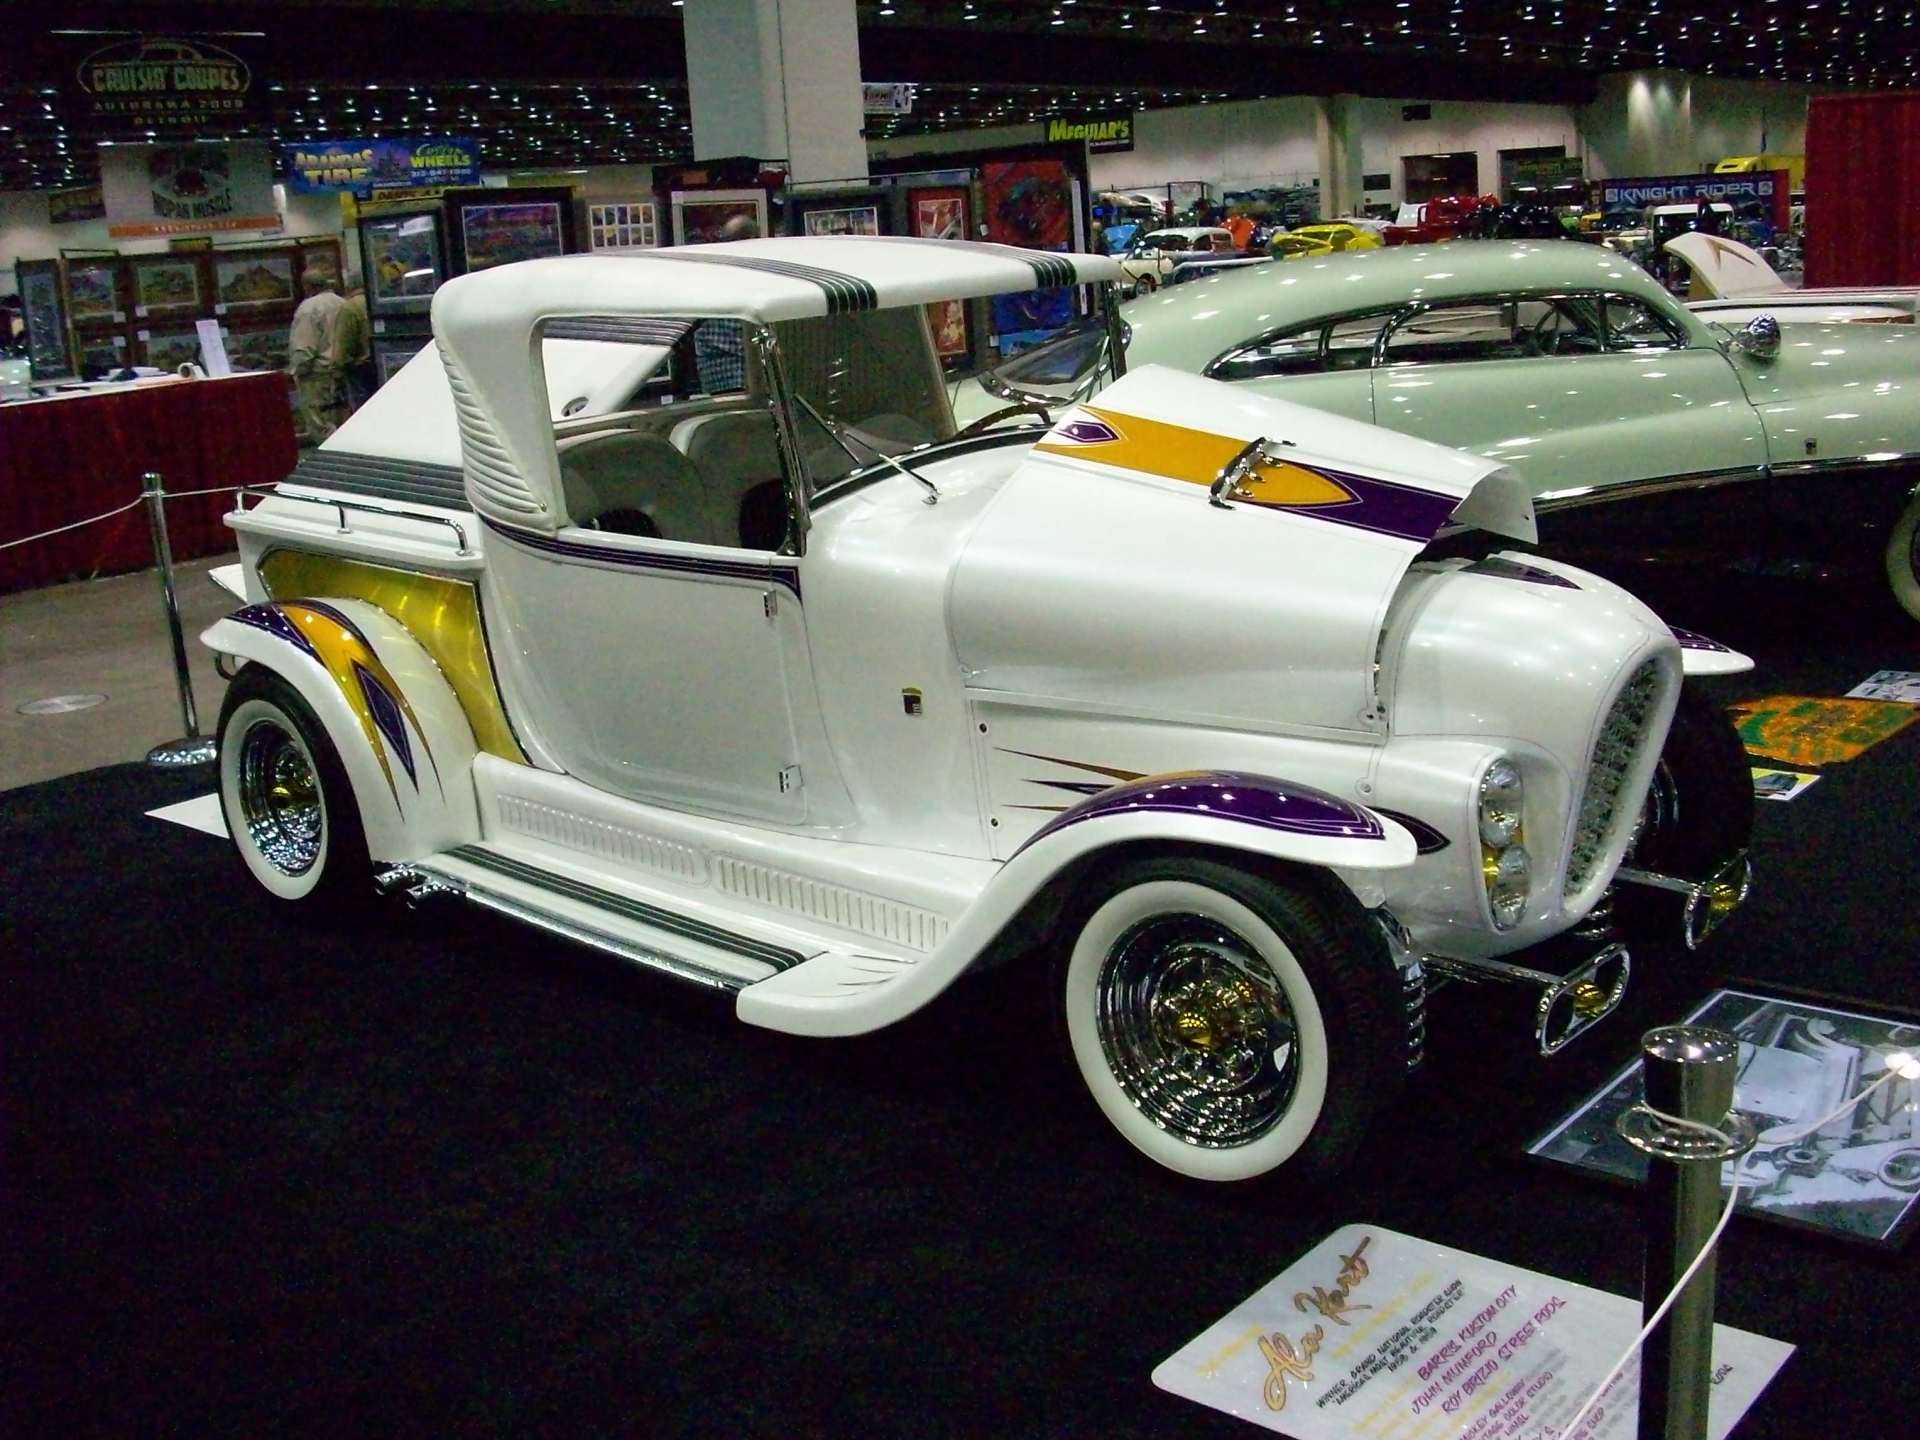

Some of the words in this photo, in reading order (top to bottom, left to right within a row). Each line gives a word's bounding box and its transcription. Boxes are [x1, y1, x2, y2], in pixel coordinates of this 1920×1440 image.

[174, 66, 240, 91] COUPES
[1049, 119, 1129, 142] MEGUIAR'S
[410, 154, 471, 168] WHEELS
[304, 168, 371, 187] TIRE
[1620, 186, 1689, 204] KNIGHT
[1376, 1325, 1411, 1355] NATIONAL
[1417, 1340, 1462, 1381] BARRIS
[1458, 1303, 1499, 1342] KUSTOM
[1495, 1284, 1517, 1309] CITY
[1412, 1382, 1443, 1415] JOHN
[1441, 1331, 1497, 1385] MUMFORD
[1441, 1390, 1462, 1414] ROY
[1462, 1359, 1499, 1396] BRIZIO
[1498, 1321, 1536, 1361] STREET
